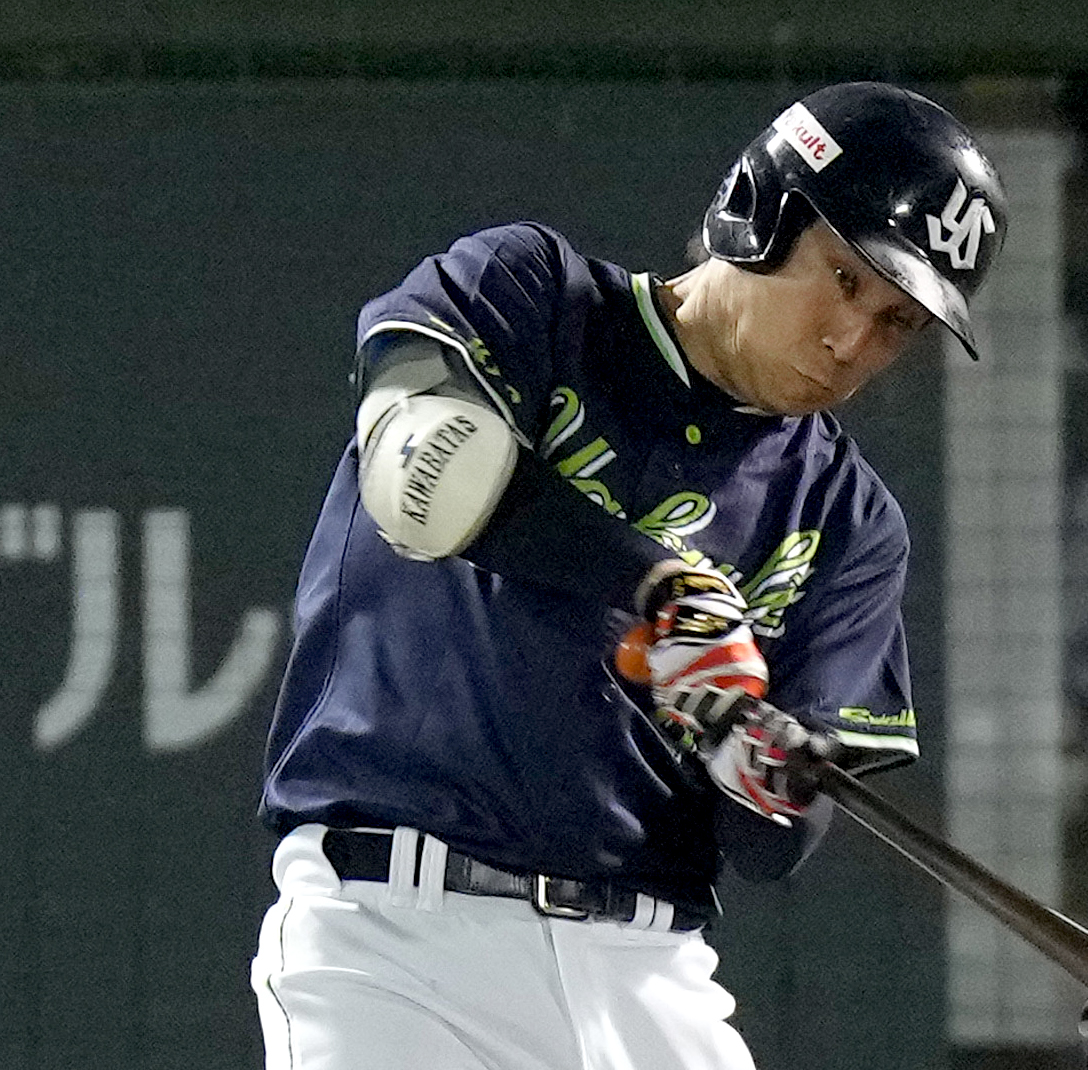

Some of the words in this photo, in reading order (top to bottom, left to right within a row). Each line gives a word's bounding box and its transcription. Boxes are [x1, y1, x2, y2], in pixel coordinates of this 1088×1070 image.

[784, 108, 827, 160] kult
[400, 415, 478, 526] KAWABATAS
[546, 386, 820, 638] Yklt
[0, 502, 281, 752] ル
